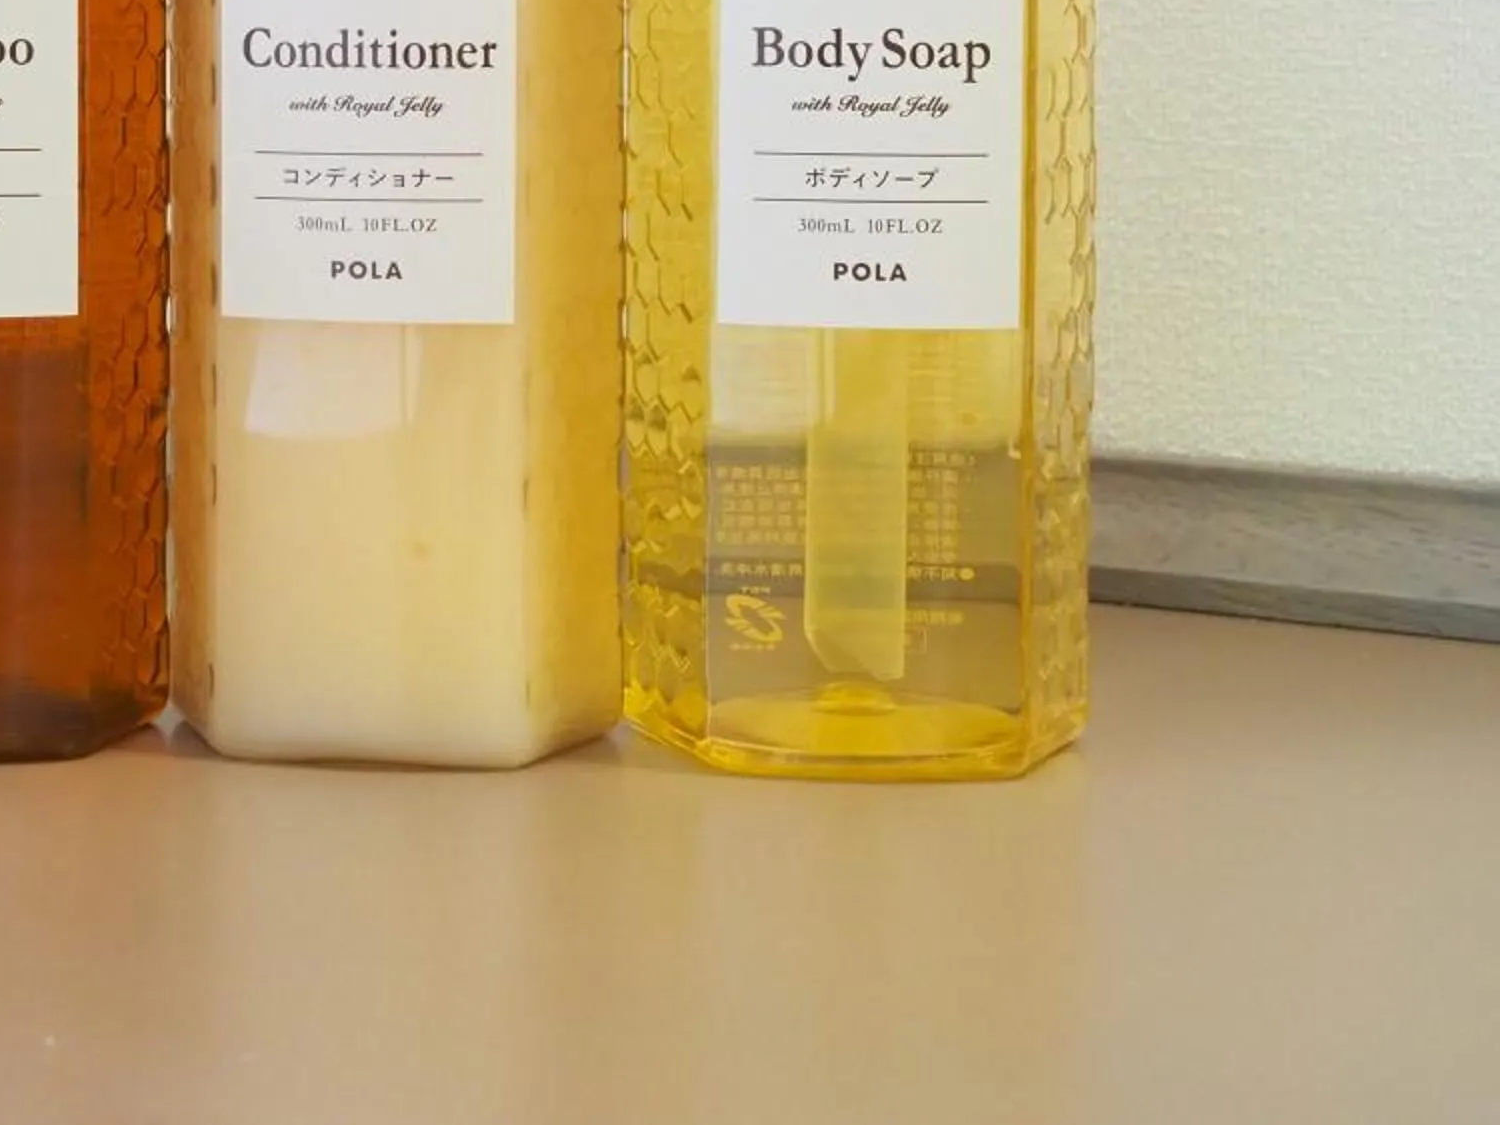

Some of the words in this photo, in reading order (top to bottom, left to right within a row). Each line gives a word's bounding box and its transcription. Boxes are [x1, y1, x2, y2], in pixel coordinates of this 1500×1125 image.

[242, 27, 498, 70] Conditioner
[751, 26, 874, 83] Body
[881, 27, 991, 84] Soap
[288, 95, 330, 112] with
[332, 94, 392, 119] Royal
[392, 95, 444, 118] Jelly
[791, 94, 834, 112] with
[836, 94, 899, 118] Royal
[899, 94, 951, 119] Jelly
[283, 166, 454, 188] コンディショナー
[804, 166, 940, 189] ボディソープ
[297, 215, 353, 233] 300mL
[363, 217, 438, 233] 10FL.OZ
[797, 218, 856, 234] 300mL
[867, 218, 943, 235] 10FL.OZ
[330, 260, 403, 280] POLA
[833, 262, 908, 282] POLA
